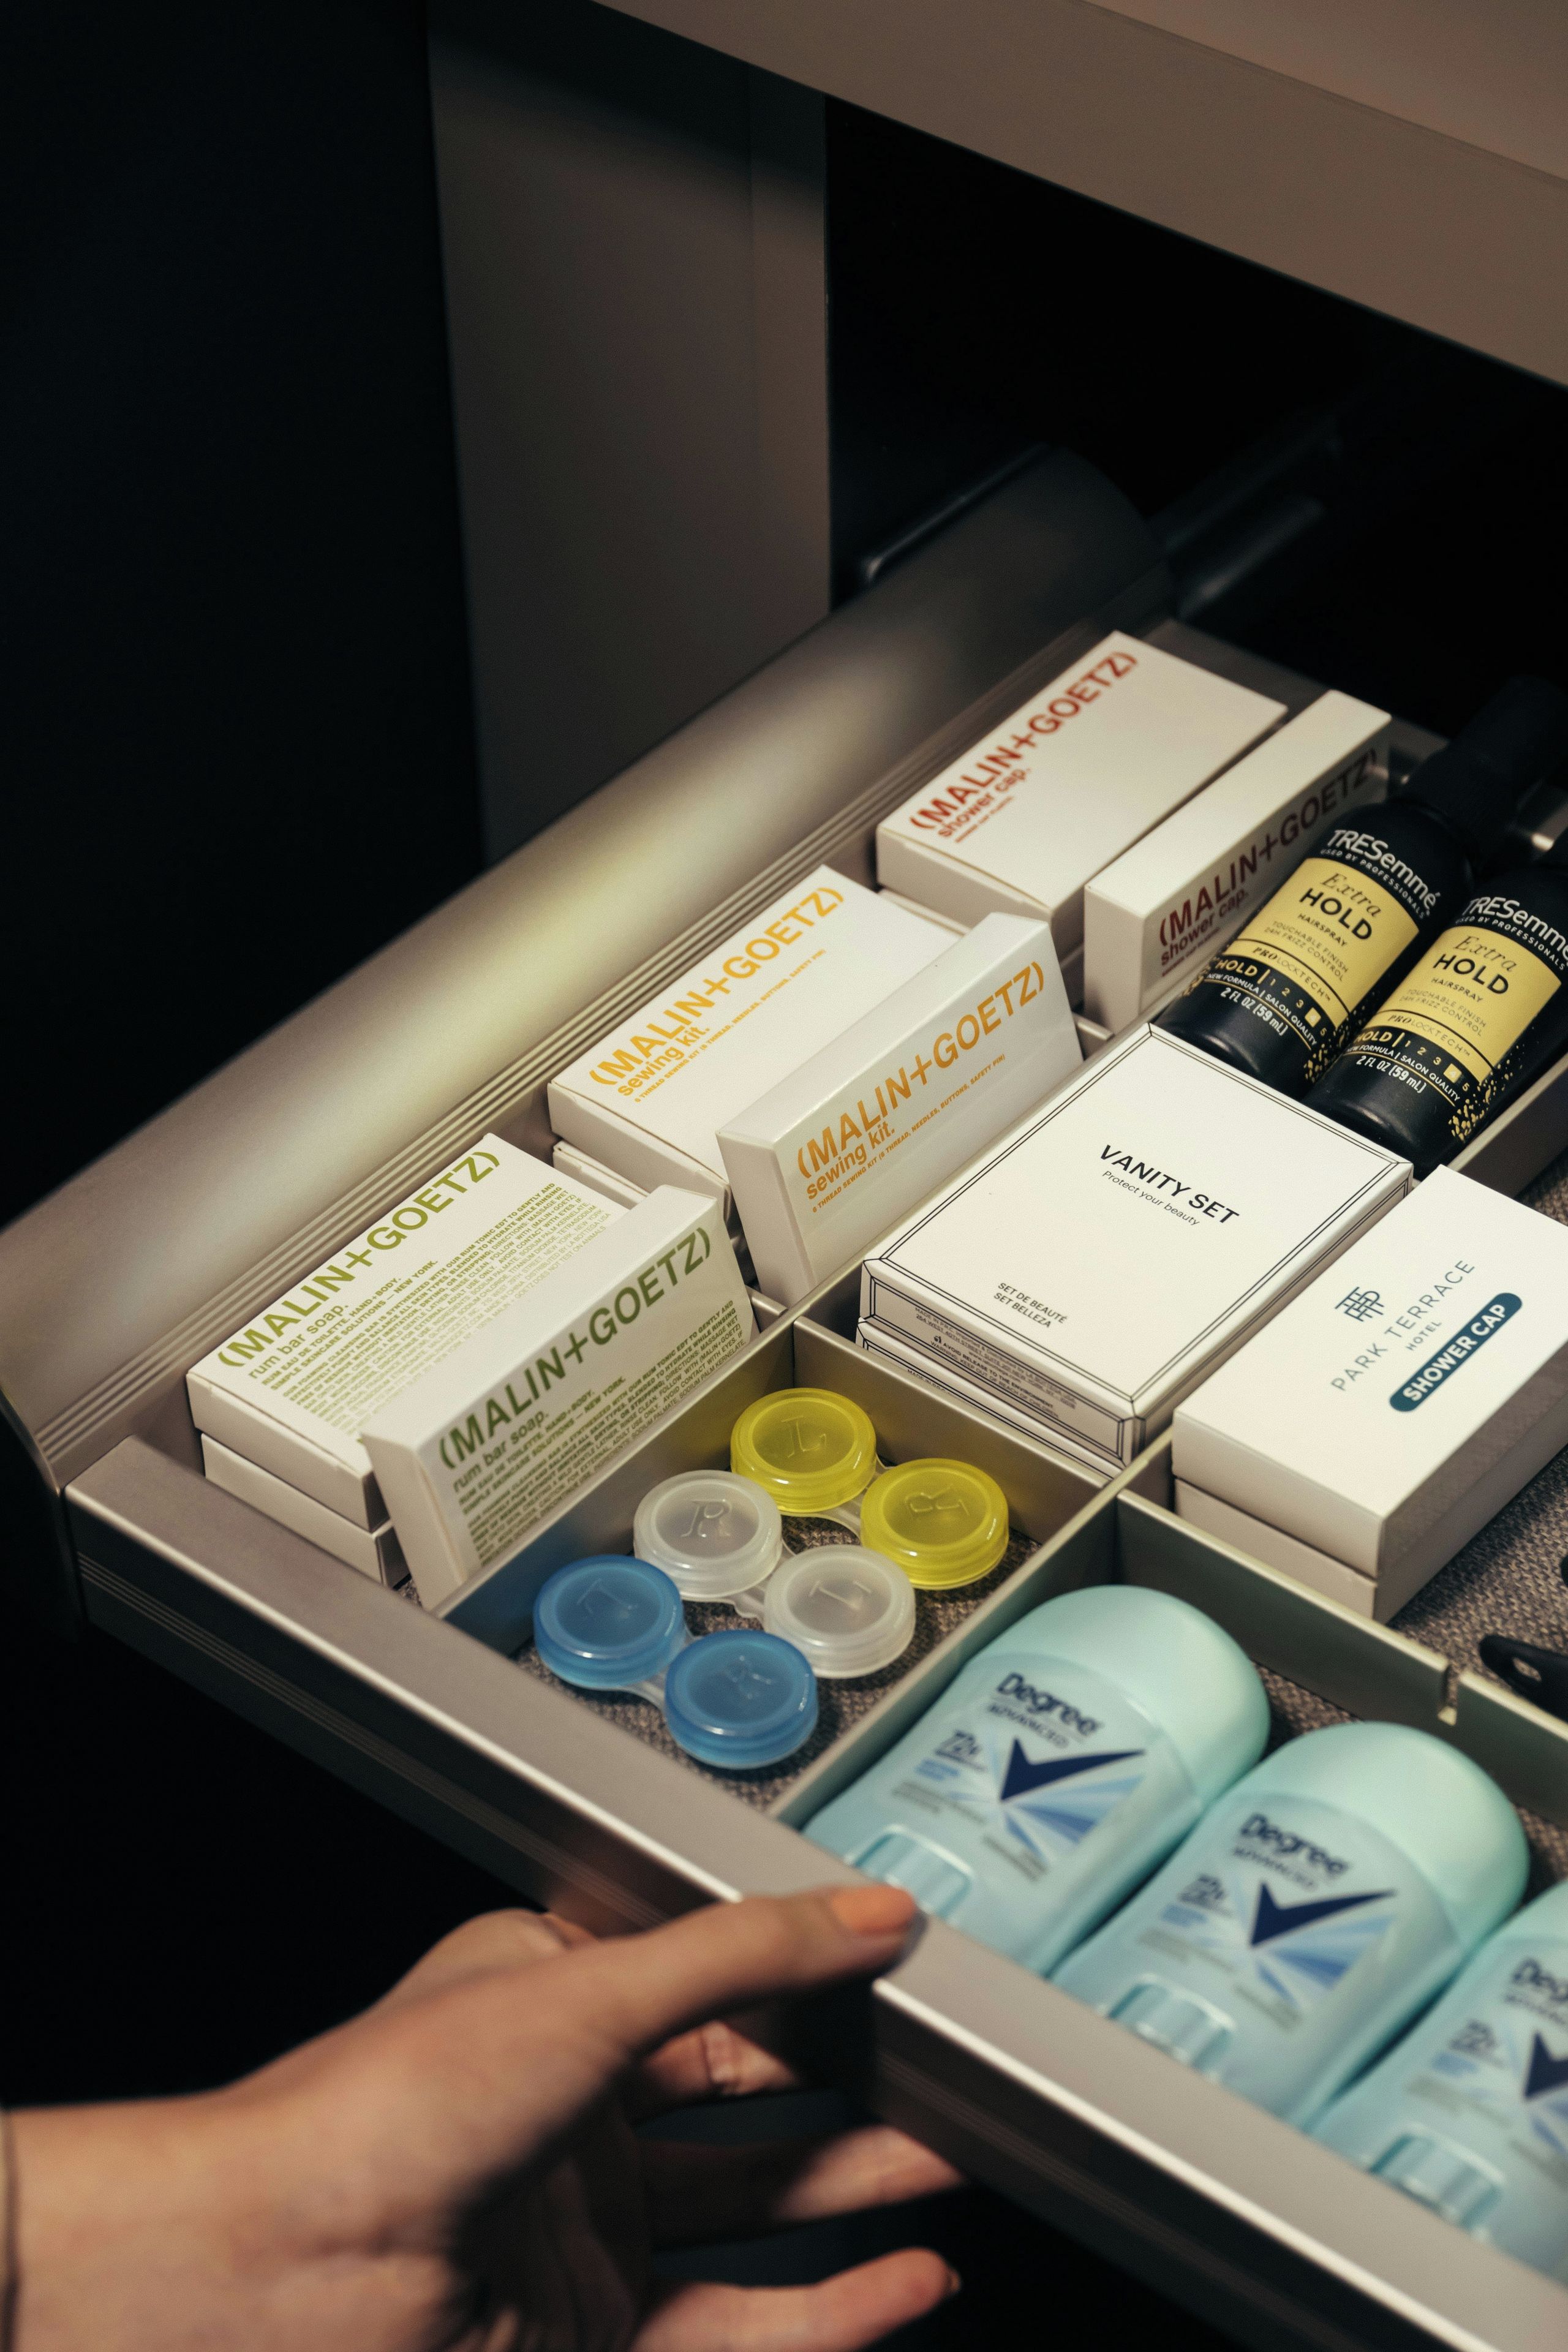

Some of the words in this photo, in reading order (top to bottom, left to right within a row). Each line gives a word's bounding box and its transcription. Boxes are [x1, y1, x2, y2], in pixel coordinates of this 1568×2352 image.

[911, 652, 1137, 830] (MALIN+GOETZ)
[938, 792, 995, 838] shower
[1299, 888, 1372, 940] HOLD
[1321, 873, 1381, 917] Extra
[1360, 859, 1424, 918] PROFESSIONALS
[1160, 918, 1216, 965] shower
[1273, 921, 1321, 948] TOUCHABLE
[1323, 948, 1349, 973] FINISH
[1282, 933, 1306, 948] FRIZZ
[1308, 946, 1344, 981] CONTROL
[1297, 913, 1348, 947] HAIRSPRAY
[1453, 935, 1517, 972] Extra
[1492, 919, 1565, 970] PROFESSIONALS
[589, 886, 845, 1086] (MALIN+GOETZ)
[1215, 960, 1257, 976] HOLD
[1296, 1000, 1303, 1009] 3
[1321, 1028, 1327, 1036] 5
[1431, 978, 1483, 1003] HAIRSPRAY
[1433, 954, 1509, 994] HOLD
[1221, 987, 1231, 998] 2
[1229, 991, 1241, 1003] FL
[1241, 997, 1256, 1010] OZ
[1253, 1003, 1273, 1022] (59
[1269, 1017, 1288, 1036] mL)
[1223, 975, 1259, 994] FORMULA
[1265, 994, 1291, 1017] SALON
[1291, 1016, 1317, 1046] QUALITY
[1408, 989, 1457, 1007] TOUCHABLE
[1458, 1005, 1487, 1028] FINISH
[1416, 997, 1441, 1009] FRIZZ
[1442, 1006, 1482, 1036] CONTROL
[617, 1046, 685, 1096] sewing
[674, 1027, 710, 1047] kit.
[639, 1078, 665, 1098] THREAD
[664, 1059, 689, 1078] SEWING
[688, 1049, 699, 1059] KIT
[797, 961, 1045, 1178] (MALIN+GOETZ)
[1356, 1055, 1366, 1065] 2
[1365, 1057, 1376, 1067] FL
[1376, 1062, 1391, 1072] OZ
[1389, 1065, 1409, 1080] (59
[1406, 1077, 1427, 1093] mL)
[1359, 1044, 1394, 1057] FORMULA
[1400, 1055, 1429, 1075] SALON
[1429, 1072, 1460, 1101] QUALITY
[1417, 1047, 1427, 1055] 2
[1433, 1057, 1442, 1065] 3
[1462, 1082, 1470, 1091] 5
[818, 1186, 842, 1208] THREAD
[842, 1166, 866, 1188] SEWING
[867, 1156, 876, 1168] KIT
[878, 1151, 885, 1160] (6
[885, 1131, 911, 1153] THREAD,
[911, 1108, 940, 1132] NEEDLES,
[940, 1084, 969, 1109] BUTTONS,
[970, 1065, 990, 1084] SAFETY
[992, 1054, 1005, 1066] PIN)
[806, 1143, 867, 1199] sewing
[868, 1121, 895, 1149] kit.
[1100, 1144, 1191, 1197] VANITY
[1188, 1194, 1240, 1223] SET
[1102, 1170, 1140, 1193] Protect
[1139, 1191, 1164, 1205] your
[1163, 1202, 1200, 1226] beauty
[386, 1281, 430, 1315] SYNTHESIZED
[429, 1267, 447, 1281] WITH
[446, 1256, 461, 1267] OUR
[460, 1244, 475, 1256] RUM
[474, 1229, 496, 1244] TONIC
[494, 1218, 508, 1229] EDT
[516, 1193, 541, 1212] GENTLY
[541, 1183, 555, 1194] AND
[449, 1251, 479, 1275] BLENDED
[486, 1221, 517, 1244] HYDRATE
[515, 1205, 537, 1221] WHILE
[535, 1186, 562, 1207] RINSING
[217, 1152, 500, 1367] (MALIN+GOETZ)
[271, 1366, 301, 1390] SIMPLE
[301, 1335, 341, 1366] SKINCARE
[341, 1300, 386, 1335] SOLUTIONS
[393, 1278, 412, 1293] NEW
[412, 1261, 437, 1278] YORK.
[993, 1292, 1013, 1305] SET
[1011, 1302, 1051, 1327] BELLEZA
[998, 1283, 1017, 1294] SET
[1016, 1292, 1031, 1303] DE
[1029, 1300, 1067, 1323] BEAUTÉ
[1330, 1343, 1387, 1391] PARK
[1384, 1260, 1475, 1338] TERRACE
[249, 1355, 281, 1379] rum
[276, 1333, 305, 1355] bar
[306, 1305, 349, 1334] soap.
[262, 1370, 282, 1385] RUM
[281, 1357, 299, 1370] EAU
[298, 1347, 311, 1357] DE
[310, 1318, 350, 1347] TOILETTE.
[349, 1278, 398, 1317] HAND+BODY.
[439, 1227, 711, 1469] (MALIN+GOETZ)
[642, 1366, 656, 1381] RUM
[657, 1349, 676, 1368] TONIC
[676, 1338, 688, 1352] EDT
[688, 1331, 698, 1341] TO
[698, 1311, 720, 1333] GENTLY
[722, 1300, 733, 1314] AND
[665, 1345, 693, 1371] HYDRATE
[693, 1329, 712, 1348] WHILE
[712, 1308, 736, 1332] RINSING
[943, 1343, 961, 1356] AVOID
[962, 1354, 987, 1371] RELEASE
[1403, 1336, 1477, 1401] SHOWER
[1471, 1304, 1505, 1335] CAP
[1405, 1321, 1442, 1351] HOTEL
[453, 1464, 481, 1492] rum
[483, 1441, 507, 1467] bar
[510, 1411, 548, 1445] soap.
[779, 1415, 827, 1458] L
[680, 1498, 733, 1539] R
[996, 1672, 1102, 1737] Degree
